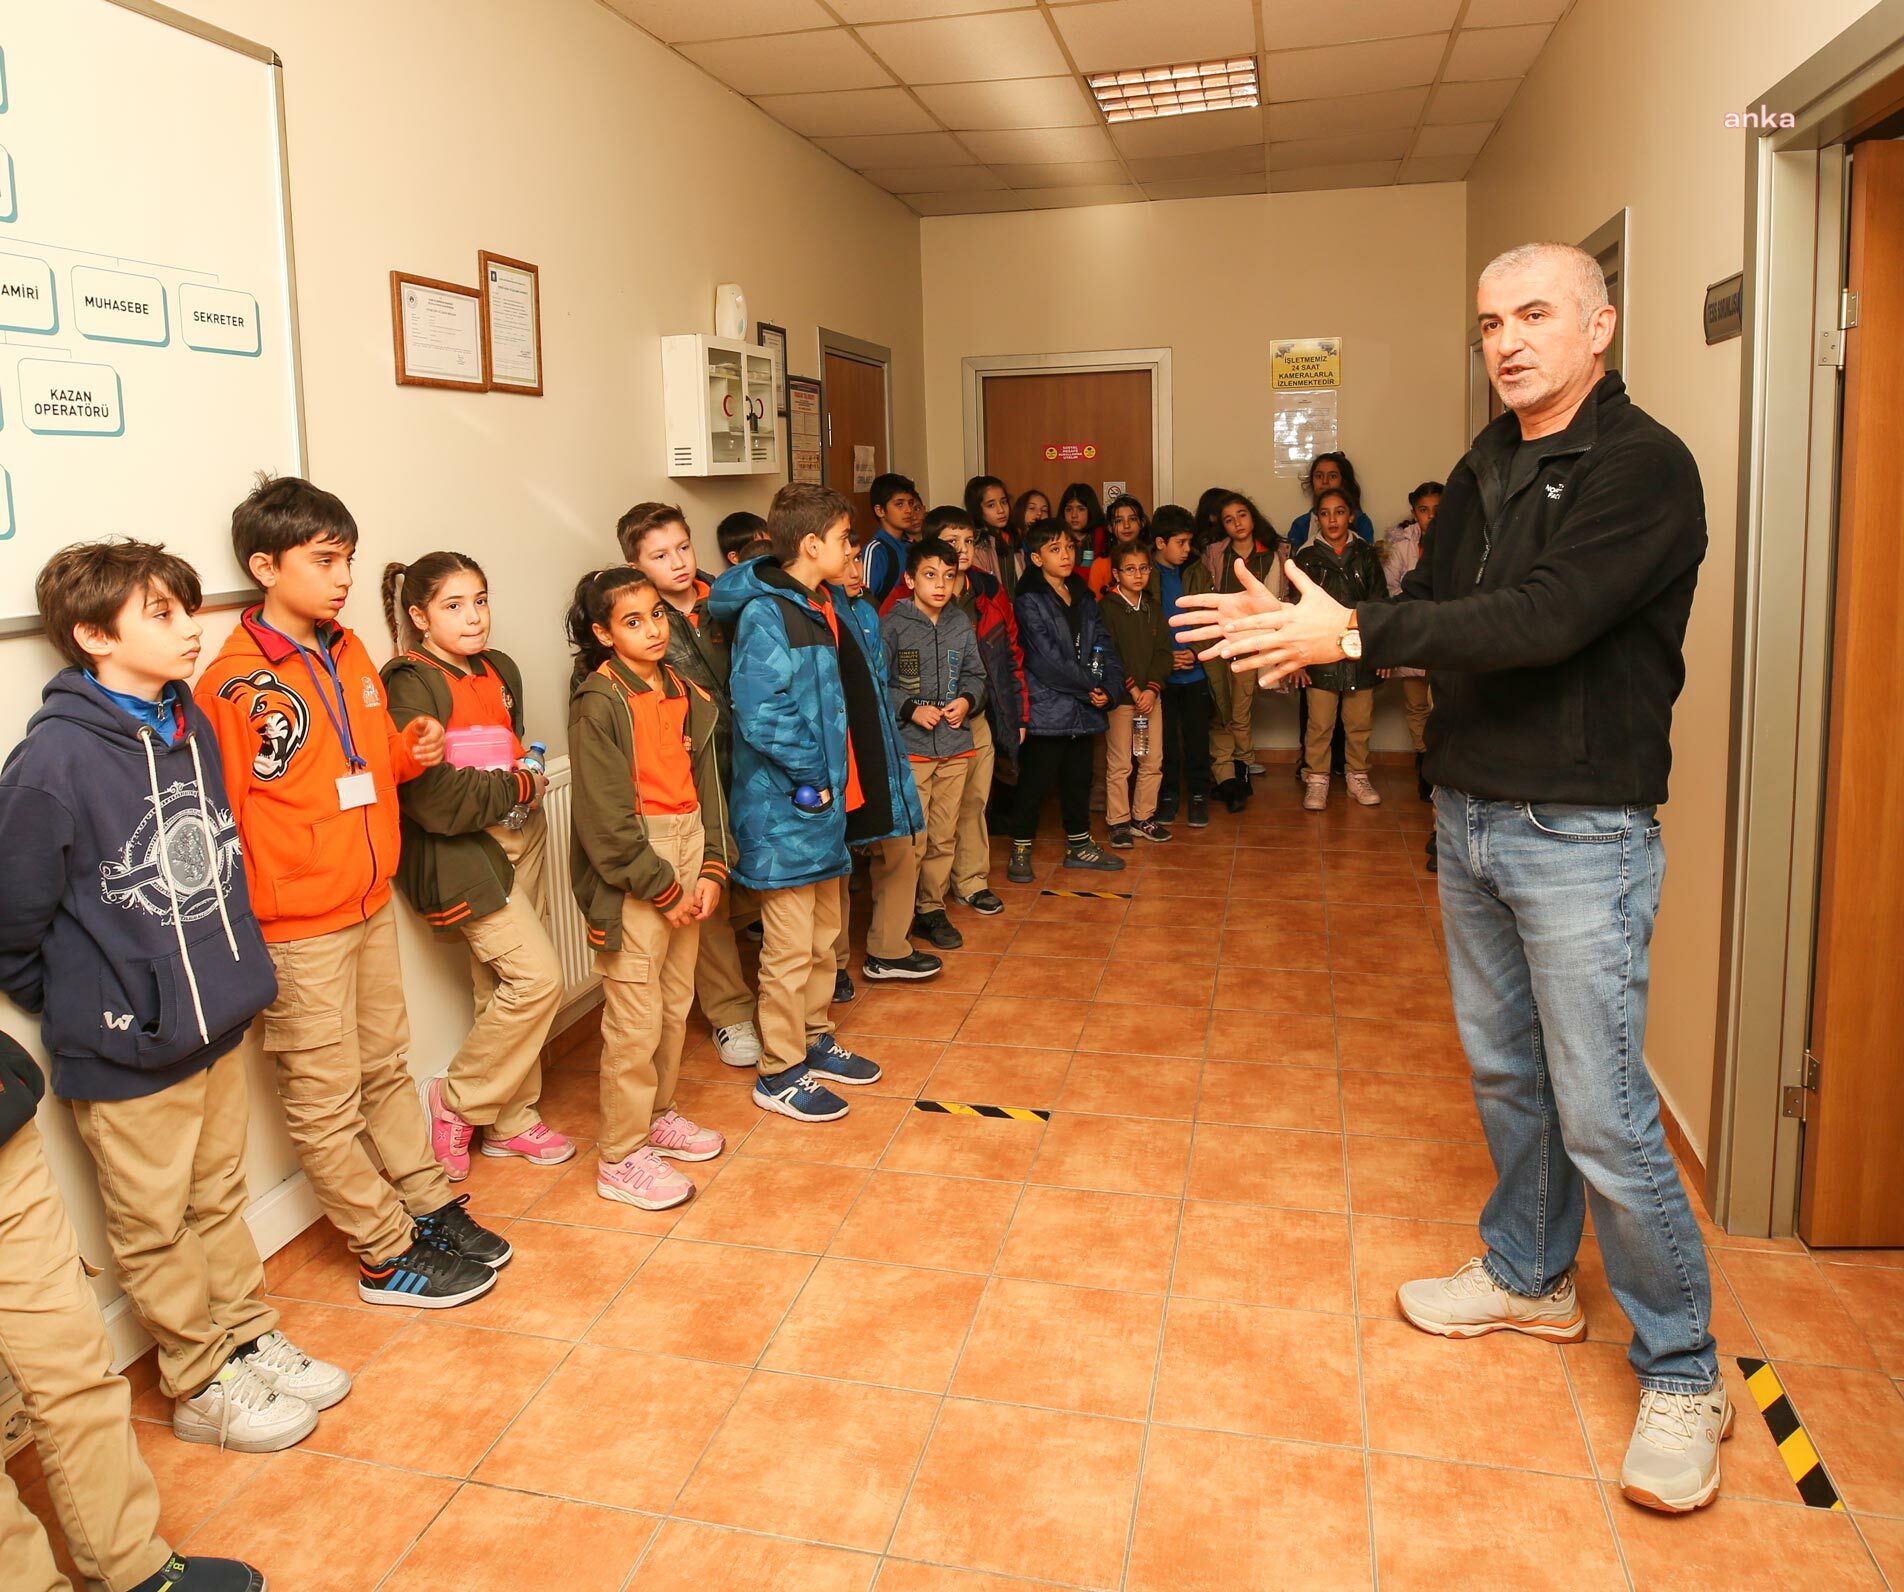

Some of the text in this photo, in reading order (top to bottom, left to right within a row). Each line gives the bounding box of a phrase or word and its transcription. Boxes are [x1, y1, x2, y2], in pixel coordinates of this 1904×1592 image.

[1, 283, 40, 300] AMİRİ
[84, 295, 150, 315] MUHASEBE
[193, 310, 245, 328] SEKRETER
[1284, 355, 1328, 364] İŞLETMEMİZ
[1301, 363, 1320, 371] SAAT
[1277, 378, 1335, 387] İZLENMEKTEDİR
[1278, 371, 1334, 379] KAMERALARLA
[49, 388, 92, 403] KAZAN
[34, 402, 109, 418] OPERATÖRÜ
